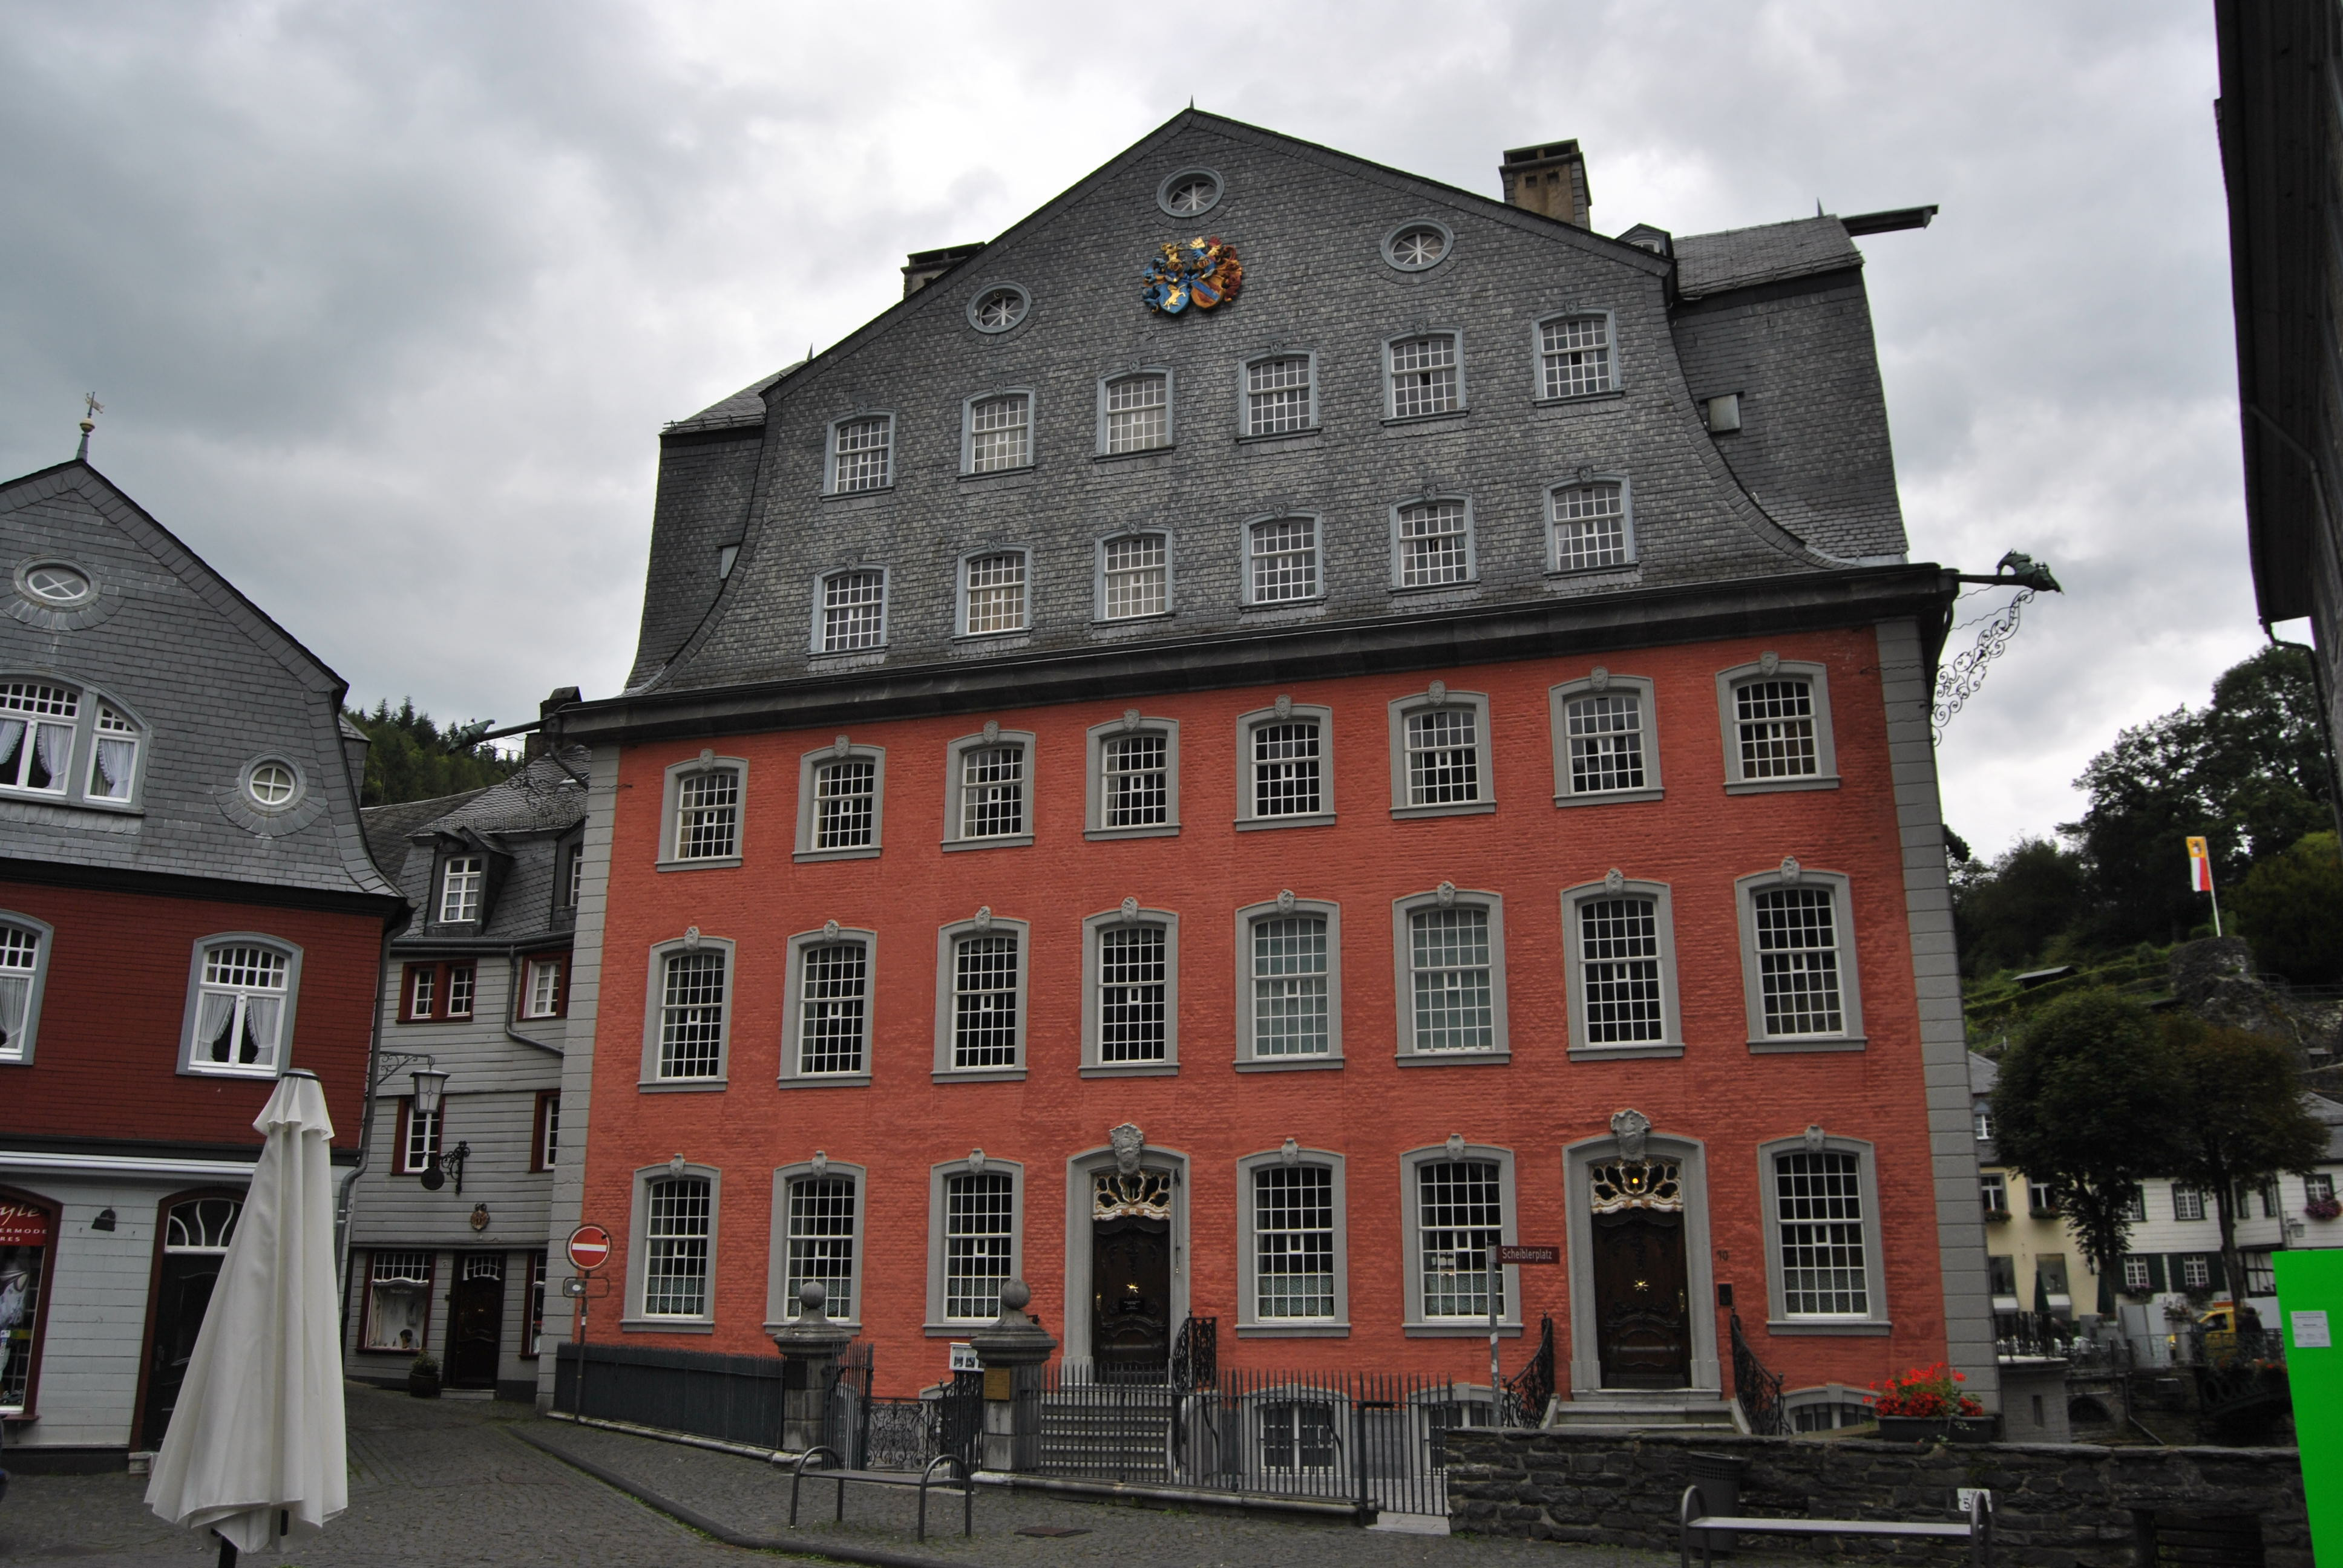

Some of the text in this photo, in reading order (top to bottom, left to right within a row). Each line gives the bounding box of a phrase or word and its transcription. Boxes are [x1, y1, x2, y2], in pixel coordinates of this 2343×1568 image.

[1502, 1248, 1552, 1262] Scheiblerplatz
[1717, 1250, 1729, 1261] 10
[1964, 1498, 1971, 1509] 5
